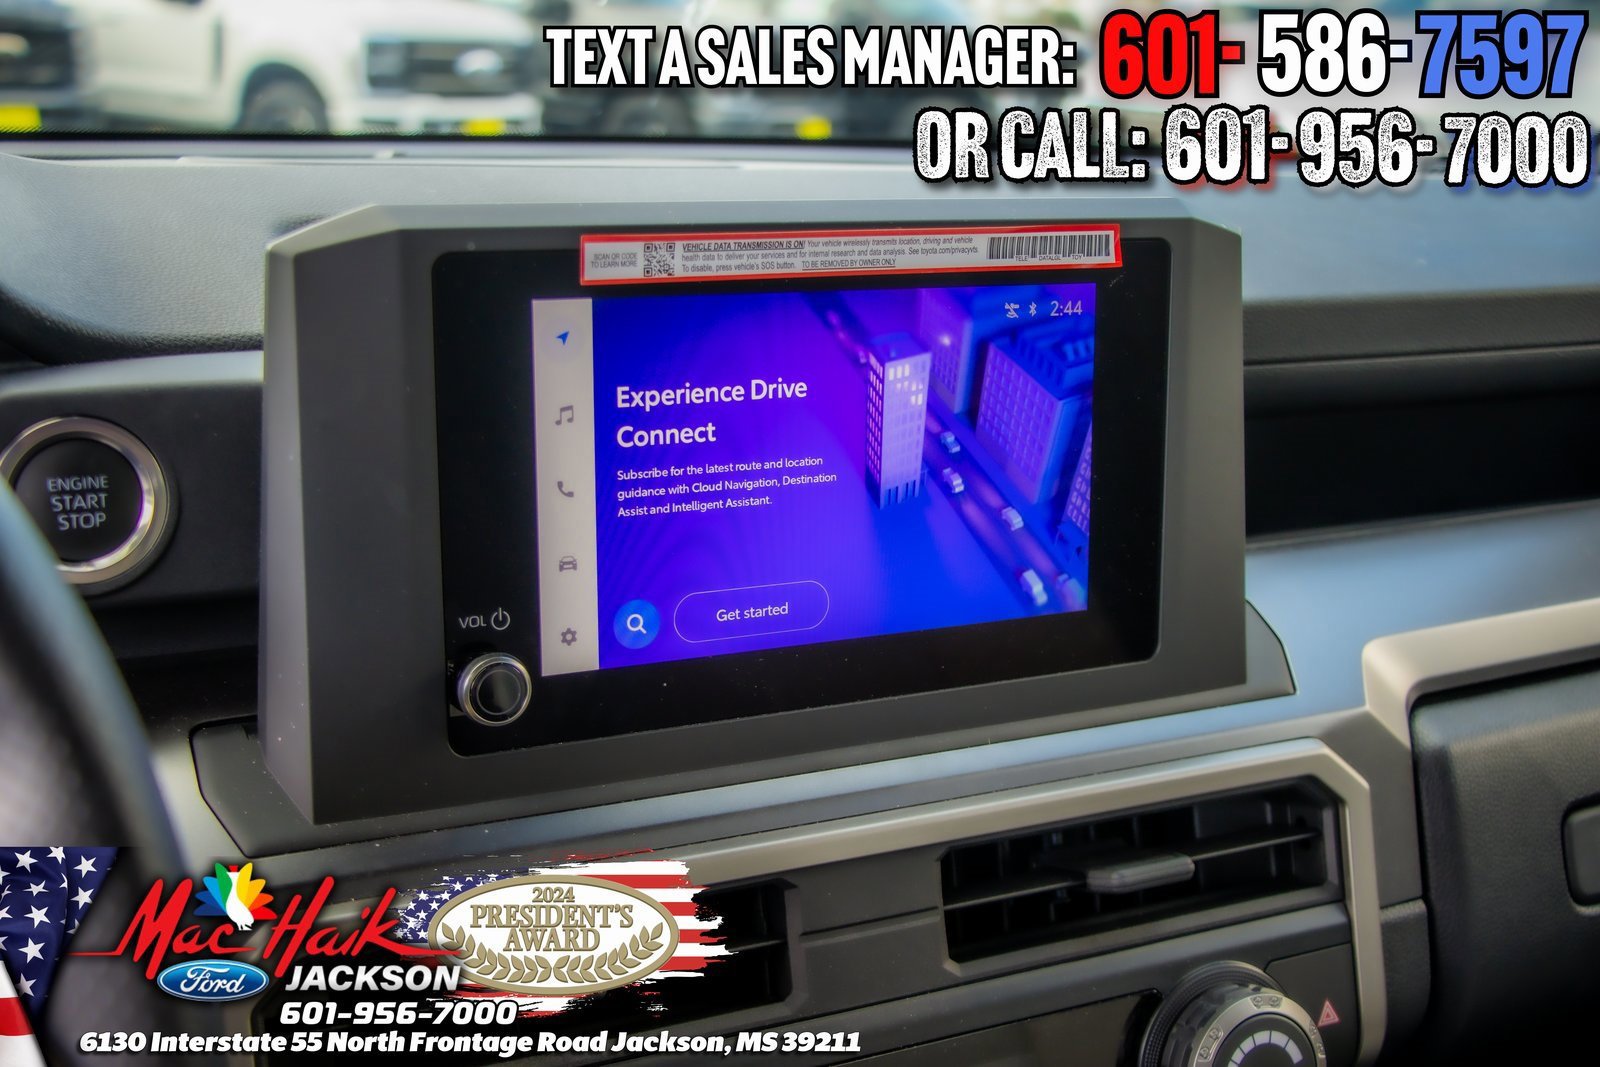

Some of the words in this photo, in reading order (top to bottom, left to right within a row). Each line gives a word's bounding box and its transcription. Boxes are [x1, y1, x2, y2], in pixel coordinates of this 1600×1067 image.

[682, 243, 713, 251] VEHICLE
[714, 242, 732, 250] DATA
[733, 240, 784, 250] TRANSMISSION
[794, 240, 806, 248] ON!
[808, 240, 820, 248] Your
[822, 239, 841, 247] vehicle
[843, 239, 870, 248] wirelessly
[898, 238, 921, 246] location,
[923, 237, 941, 246] driving
[621, 252, 638, 260] CODE
[682, 253, 700, 262] health
[702, 253, 716, 261] data
[725, 252, 745, 260] deliver
[746, 252, 760, 261] your
[761, 251, 785, 259] services
[808, 250, 830, 258] internal
[831, 249, 856, 257] research
[908, 246, 920, 254] See
[600, 260, 620, 268] LEARN
[682, 264, 690, 272] To
[690, 264, 714, 272] disable,
[716, 264, 732, 272] press
[734, 262, 760, 271] vehicle's
[761, 262, 775, 270] SOS
[776, 261, 795, 270] button.
[820, 260, 850, 268] REMOVED
[1050, 300, 1083, 317] 2:44
[616, 382, 745, 412] Experience
[751, 377, 808, 401] Drive
[616, 422, 717, 448] Connect
[617, 467, 669, 481] Subscribe
[670, 466, 685, 476] for
[686, 464, 704, 475] the
[706, 464, 734, 474] latest
[735, 462, 762, 472] route
[764, 458, 783, 469] and
[786, 456, 824, 468] location
[47, 475, 109, 492] ENGINE
[617, 487, 666, 502] guidance
[668, 484, 690, 494] with
[692, 481, 723, 493] Cloud
[724, 478, 780, 490] Navigation,
[782, 474, 837, 486] Destination
[51, 493, 108, 512] START
[617, 506, 648, 518] Assist
[649, 503, 670, 515] and
[672, 500, 724, 513] Intelligent
[725, 496, 773, 508] Assistant.
[57, 513, 106, 531] STOP
[716, 609, 741, 623] Get
[744, 602, 789, 620] started
[458, 615, 487, 629] VOL
